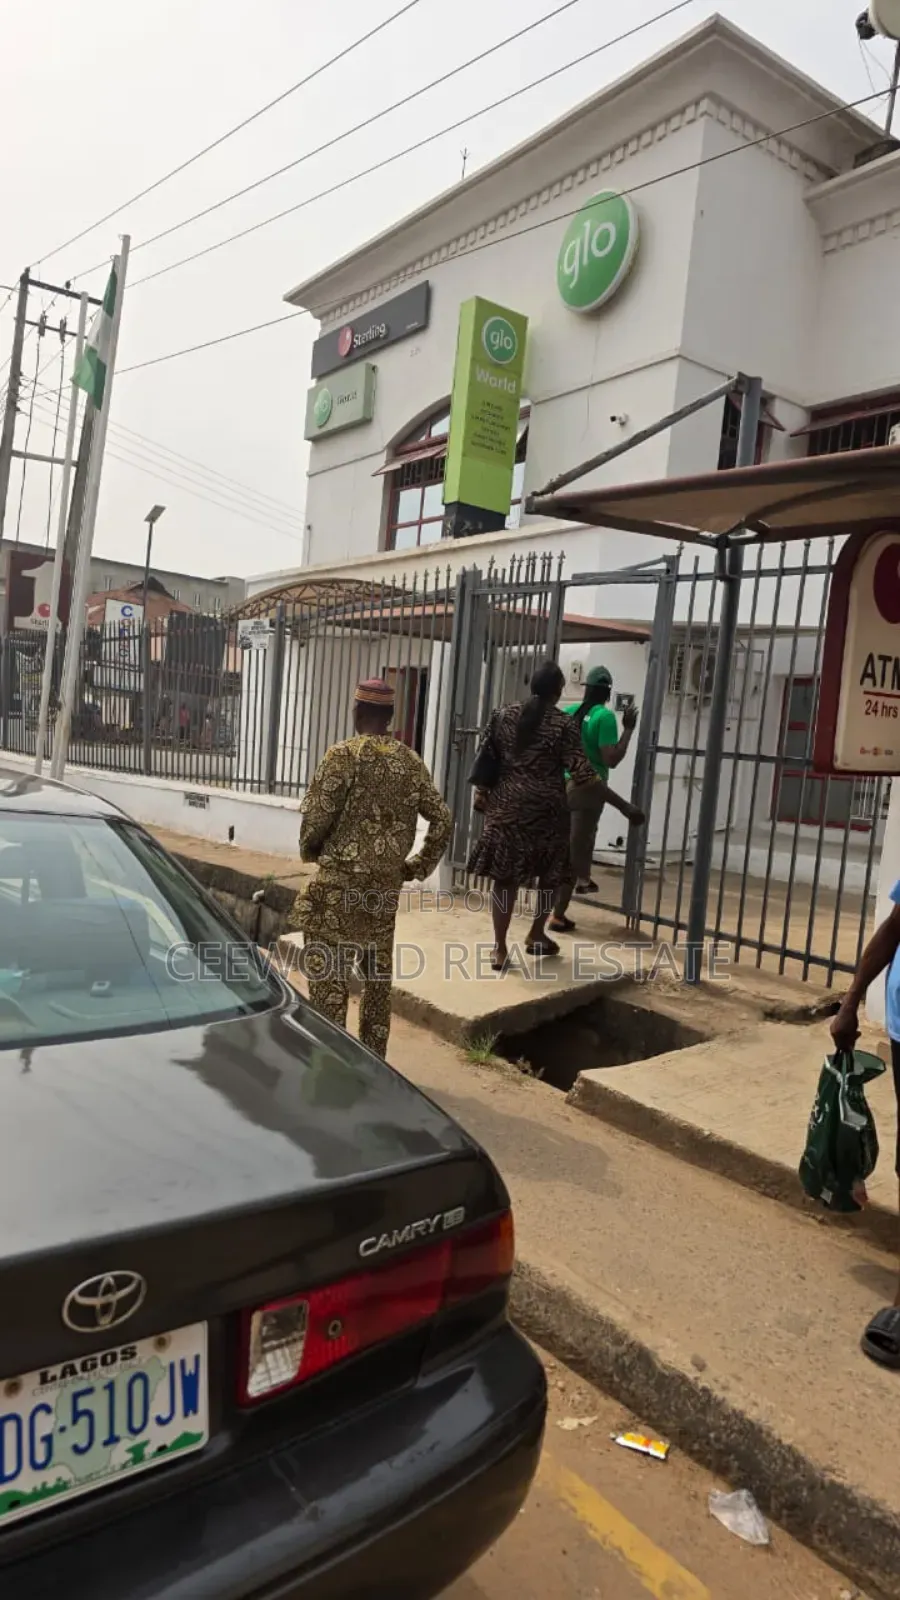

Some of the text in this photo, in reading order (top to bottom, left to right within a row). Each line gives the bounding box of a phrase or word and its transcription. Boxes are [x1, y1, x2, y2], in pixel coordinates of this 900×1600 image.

[562, 218, 618, 289] glo
[353, 322, 386, 348] Sterling
[490, 328, 513, 350] glo
[475, 364, 517, 394] World
[864, 699, 899, 719] 24 hrs
[359, 1214, 442, 1257] CAMRY
[39, 1344, 138, 1386] LAGOS
